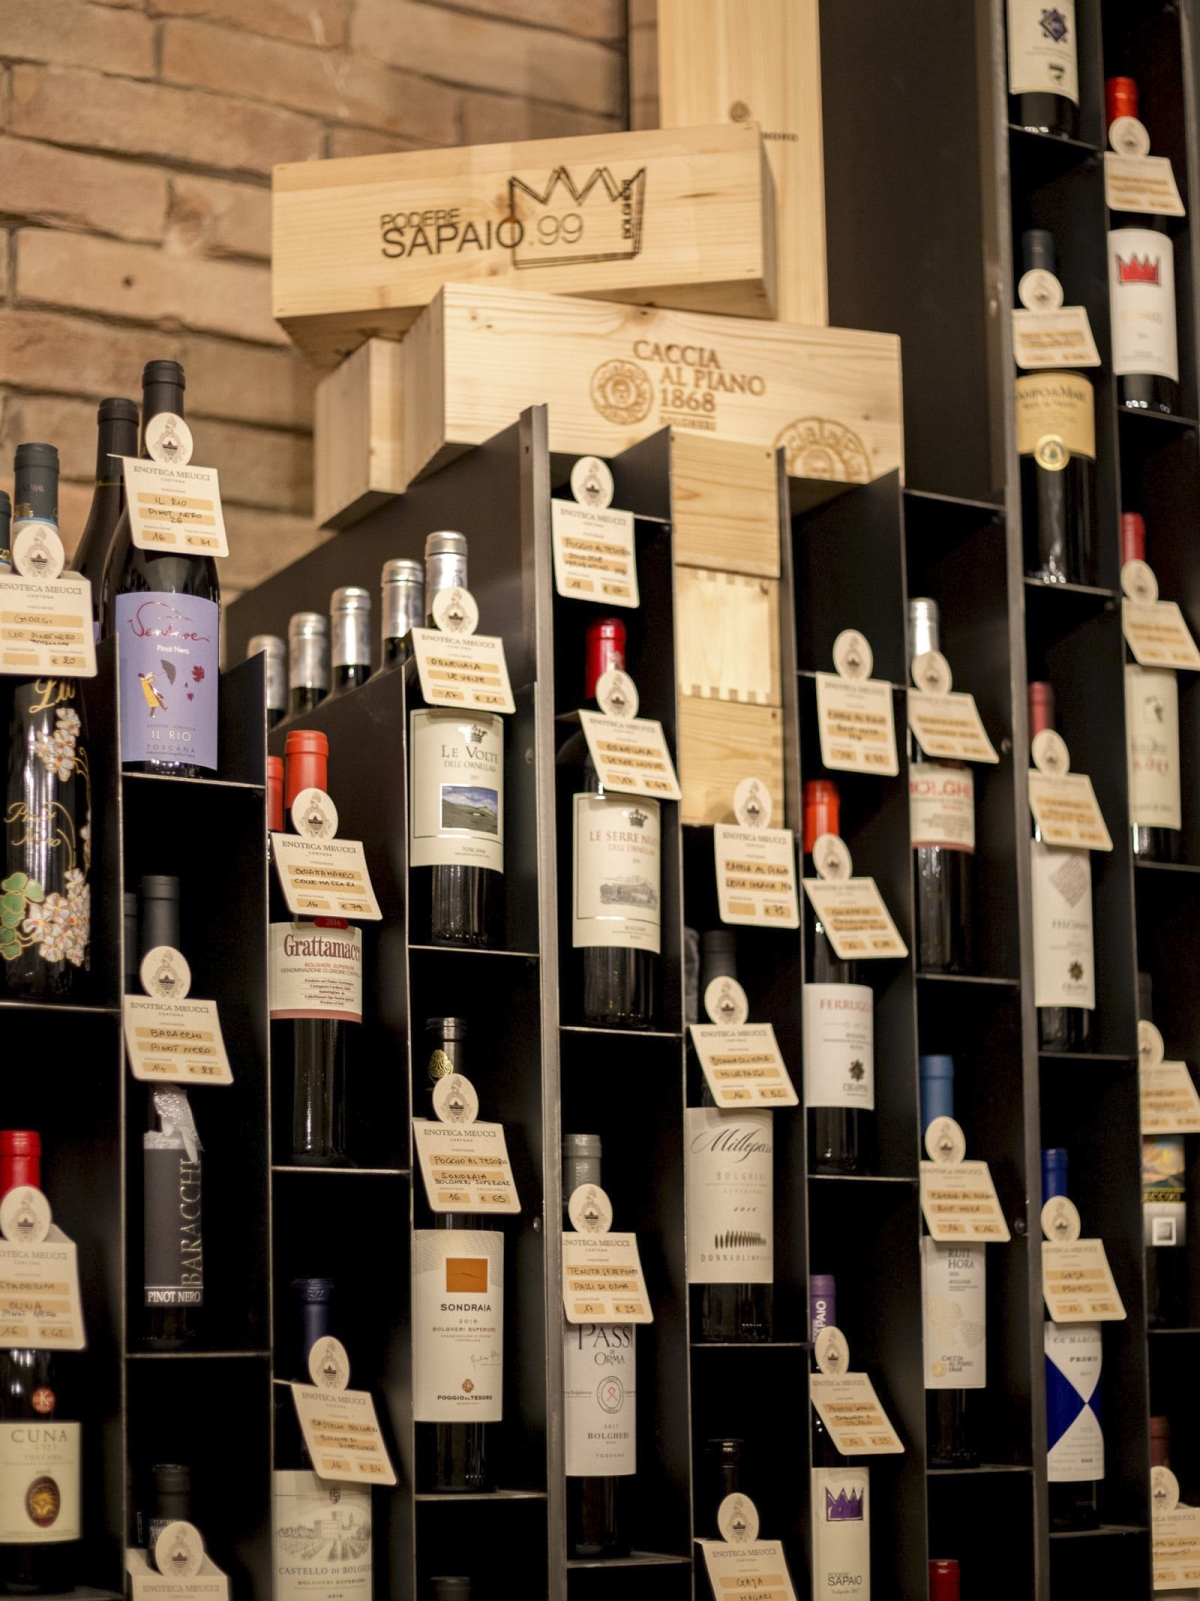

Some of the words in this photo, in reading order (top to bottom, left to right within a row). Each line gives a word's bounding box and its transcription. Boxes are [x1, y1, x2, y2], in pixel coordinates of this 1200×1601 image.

[380, 208, 461, 230] PODERE
[381, 216, 525, 258] SAPAIO
[632, 339, 721, 370] CACCIA
[659, 367, 687, 386] AL
[694, 369, 766, 396] PIANO
[660, 388, 716, 413] 1868
[134, 466, 175, 477] ENOTECA
[177, 471, 211, 481] MEUCCI
[0, 583, 43, 592] ENOTECA
[45, 586, 82, 595] MEUCCI
[422, 634, 460, 644] ENOTECA
[463, 638, 495, 648] MEUCCI
[156, 644, 173, 653] Pinot
[174, 645, 190, 654] Nero
[151, 730, 161, 739] IL
[169, 731, 191, 742] RIO
[147, 744, 195, 753] TOSCANA
[589, 830, 601, 841] LE
[606, 831, 639, 843] SERRE
[282, 841, 322, 850] ENOTECA
[324, 845, 356, 854] MEUCCI
[131, 1002, 172, 1011] ENOTECA
[175, 1005, 209, 1013] MEUCCI
[151, 1044, 180, 1052] PINOT
[424, 1129, 463, 1137] ENOTECA
[180, 1159, 202, 1287] BARACCHI
[31, 1251, 67, 1260] MEUCCI
[148, 1291, 176, 1303] PINOT
[177, 1291, 201, 1303] NERO
[440, 1303, 492, 1312] SONDRAIA
[594, 1352, 625, 1366] ORMA
[302, 1392, 336, 1402] ENOTECA
[338, 1397, 366, 1405] MEUCCI
[11, 1429, 67, 1443] CUNA
[587, 1432, 629, 1440] BOLGHERI
[712, 1550, 747, 1558] ENOTECA
[278, 1567, 328, 1575] CASTELLO
[828, 1576, 862, 1586] SAPAIO
[142, 1585, 184, 1593] ENOTECA
